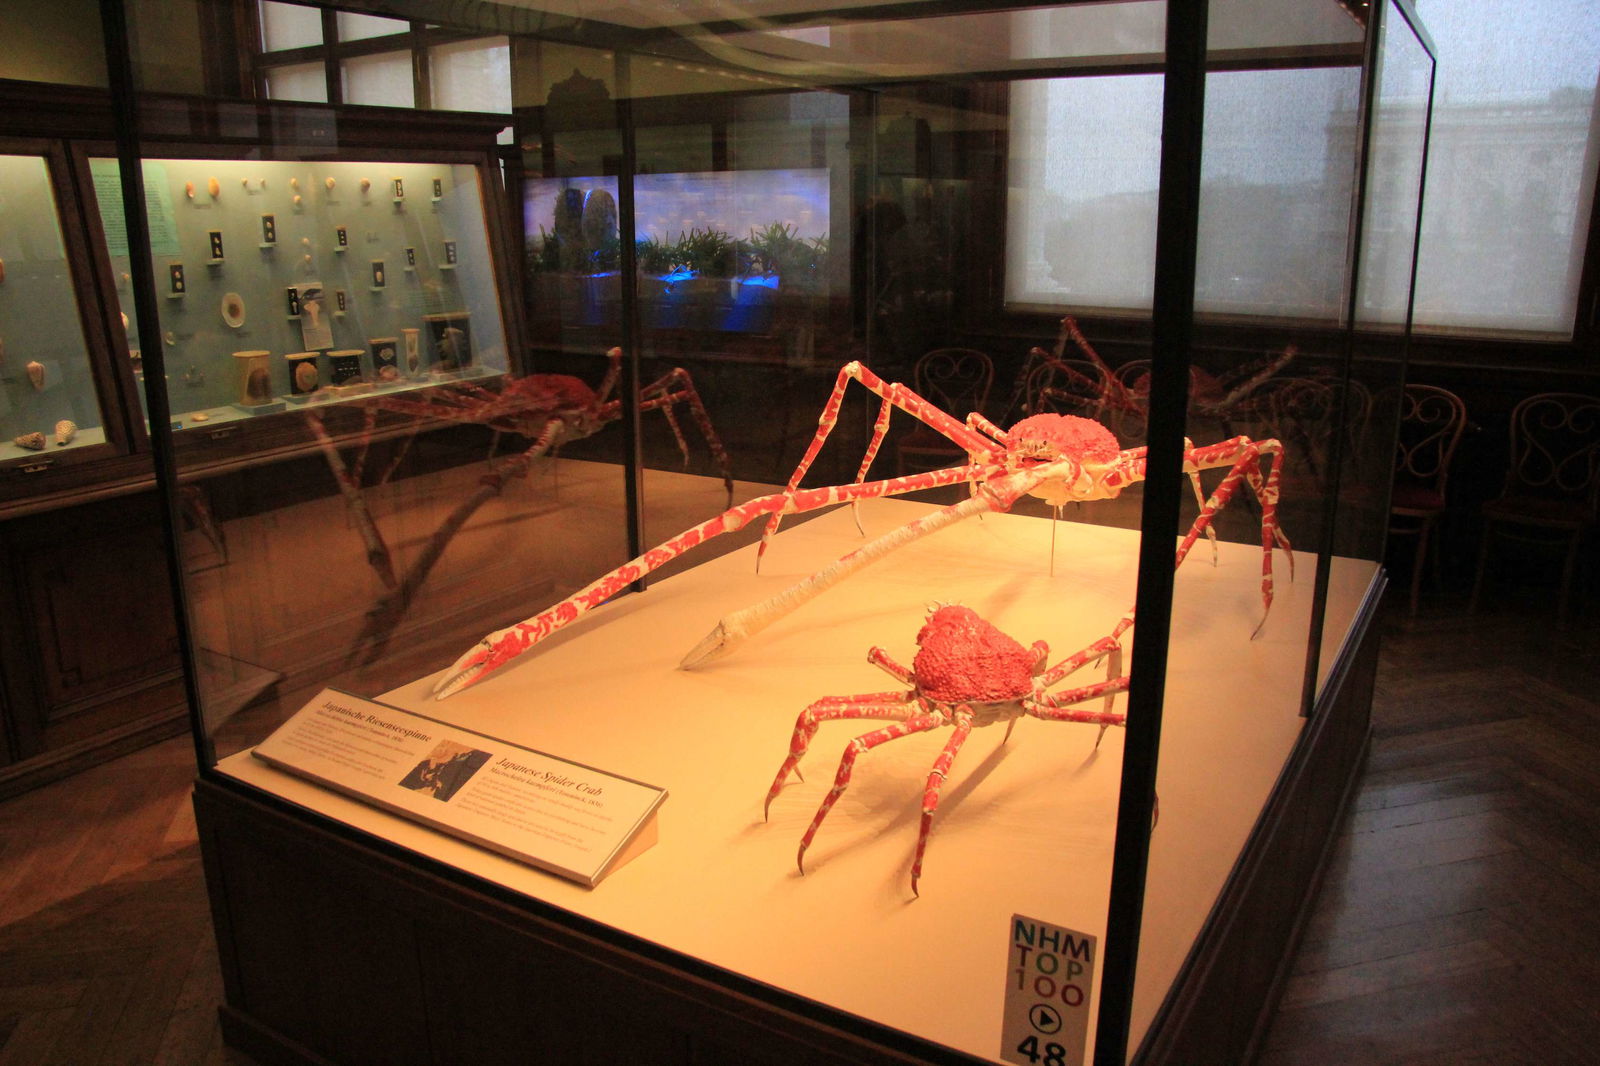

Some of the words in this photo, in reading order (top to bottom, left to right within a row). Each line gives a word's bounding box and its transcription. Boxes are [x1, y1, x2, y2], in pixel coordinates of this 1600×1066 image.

[322, 701, 365, 721] Japanische
[366, 713, 432, 742] Riesenseespinne
[496, 758, 542, 777] Japanese
[541, 771, 575, 788] Spider
[576, 782, 603, 796] Crab
[1014, 919, 1091, 963] NHM
[1015, 944, 1084, 981] TOP
[1015, 969, 1085, 1007] 100
[1017, 1035, 1067, 1066] 48
